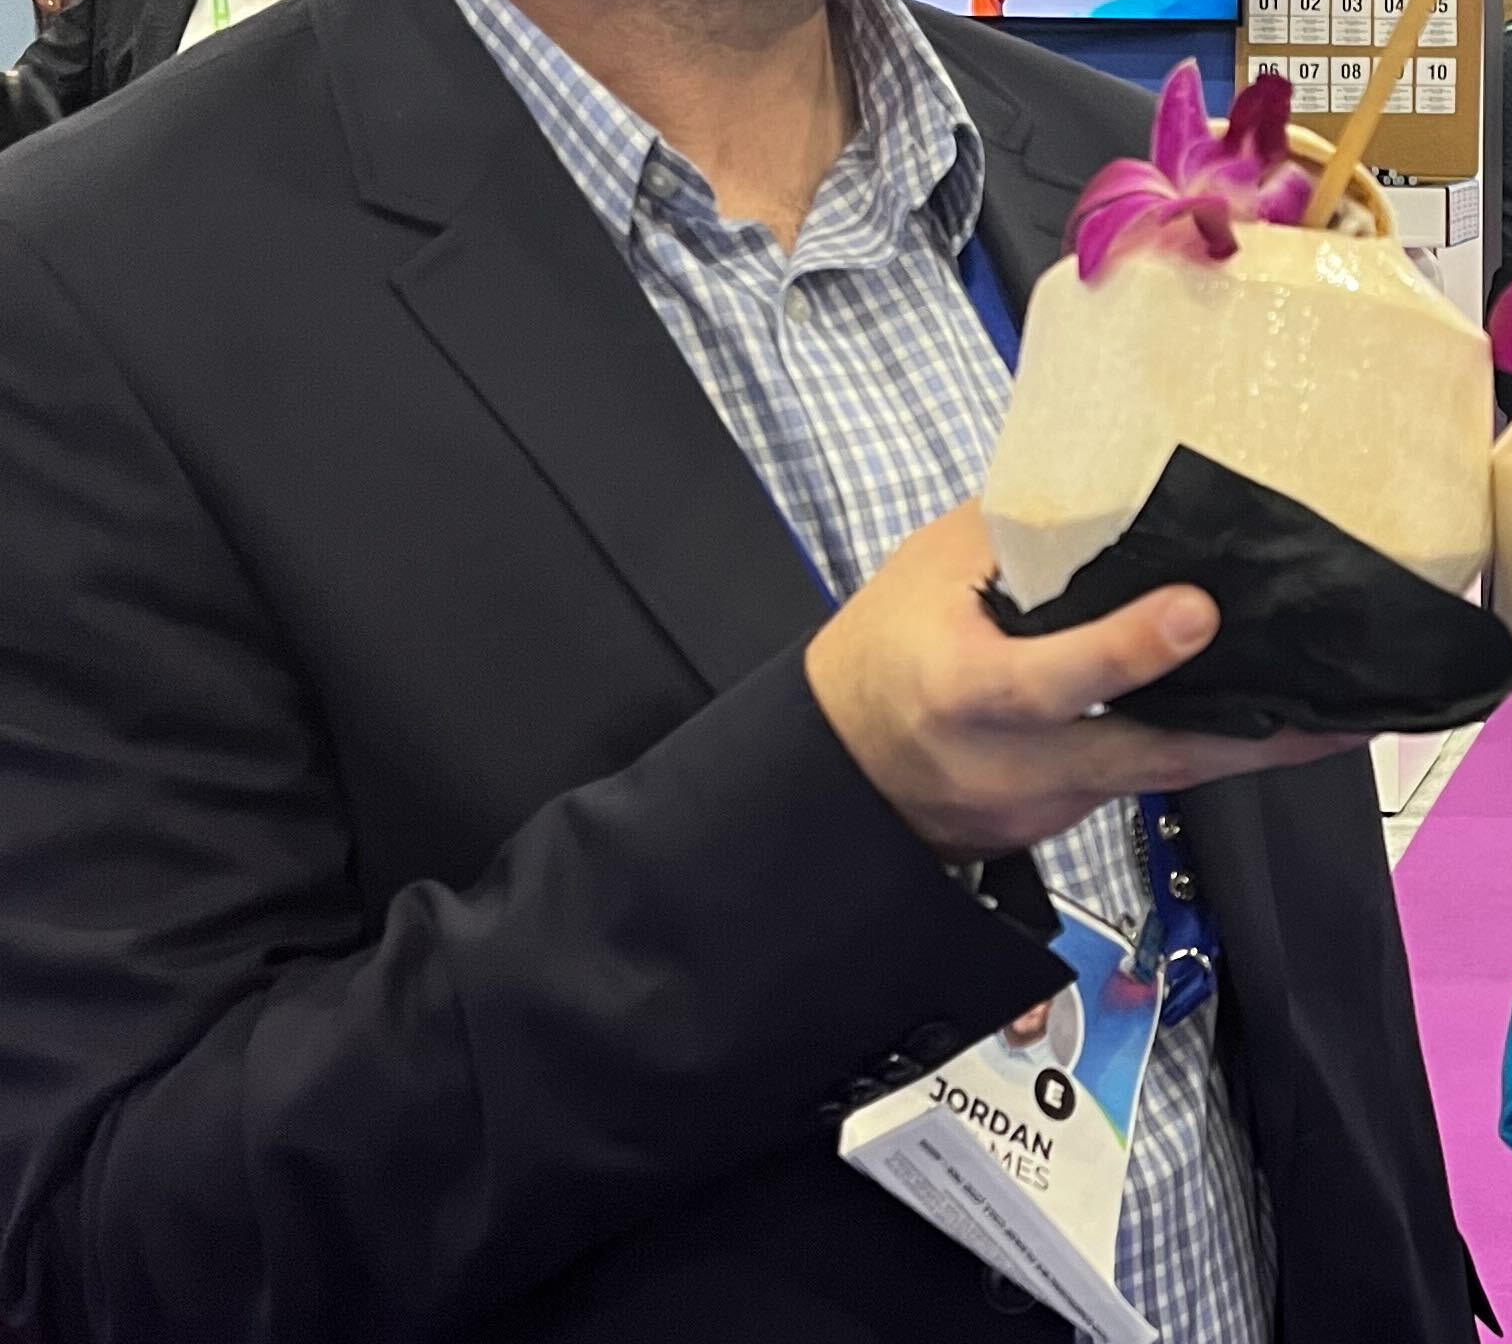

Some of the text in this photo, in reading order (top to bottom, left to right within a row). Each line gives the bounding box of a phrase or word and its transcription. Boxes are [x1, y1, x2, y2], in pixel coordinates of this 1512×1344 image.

[1299, 63, 1320, 80] 07
[1340, 63, 1361, 80] 08
[1428, 64, 1448, 81] 10
[929, 1076, 1053, 1161] JORDAN
